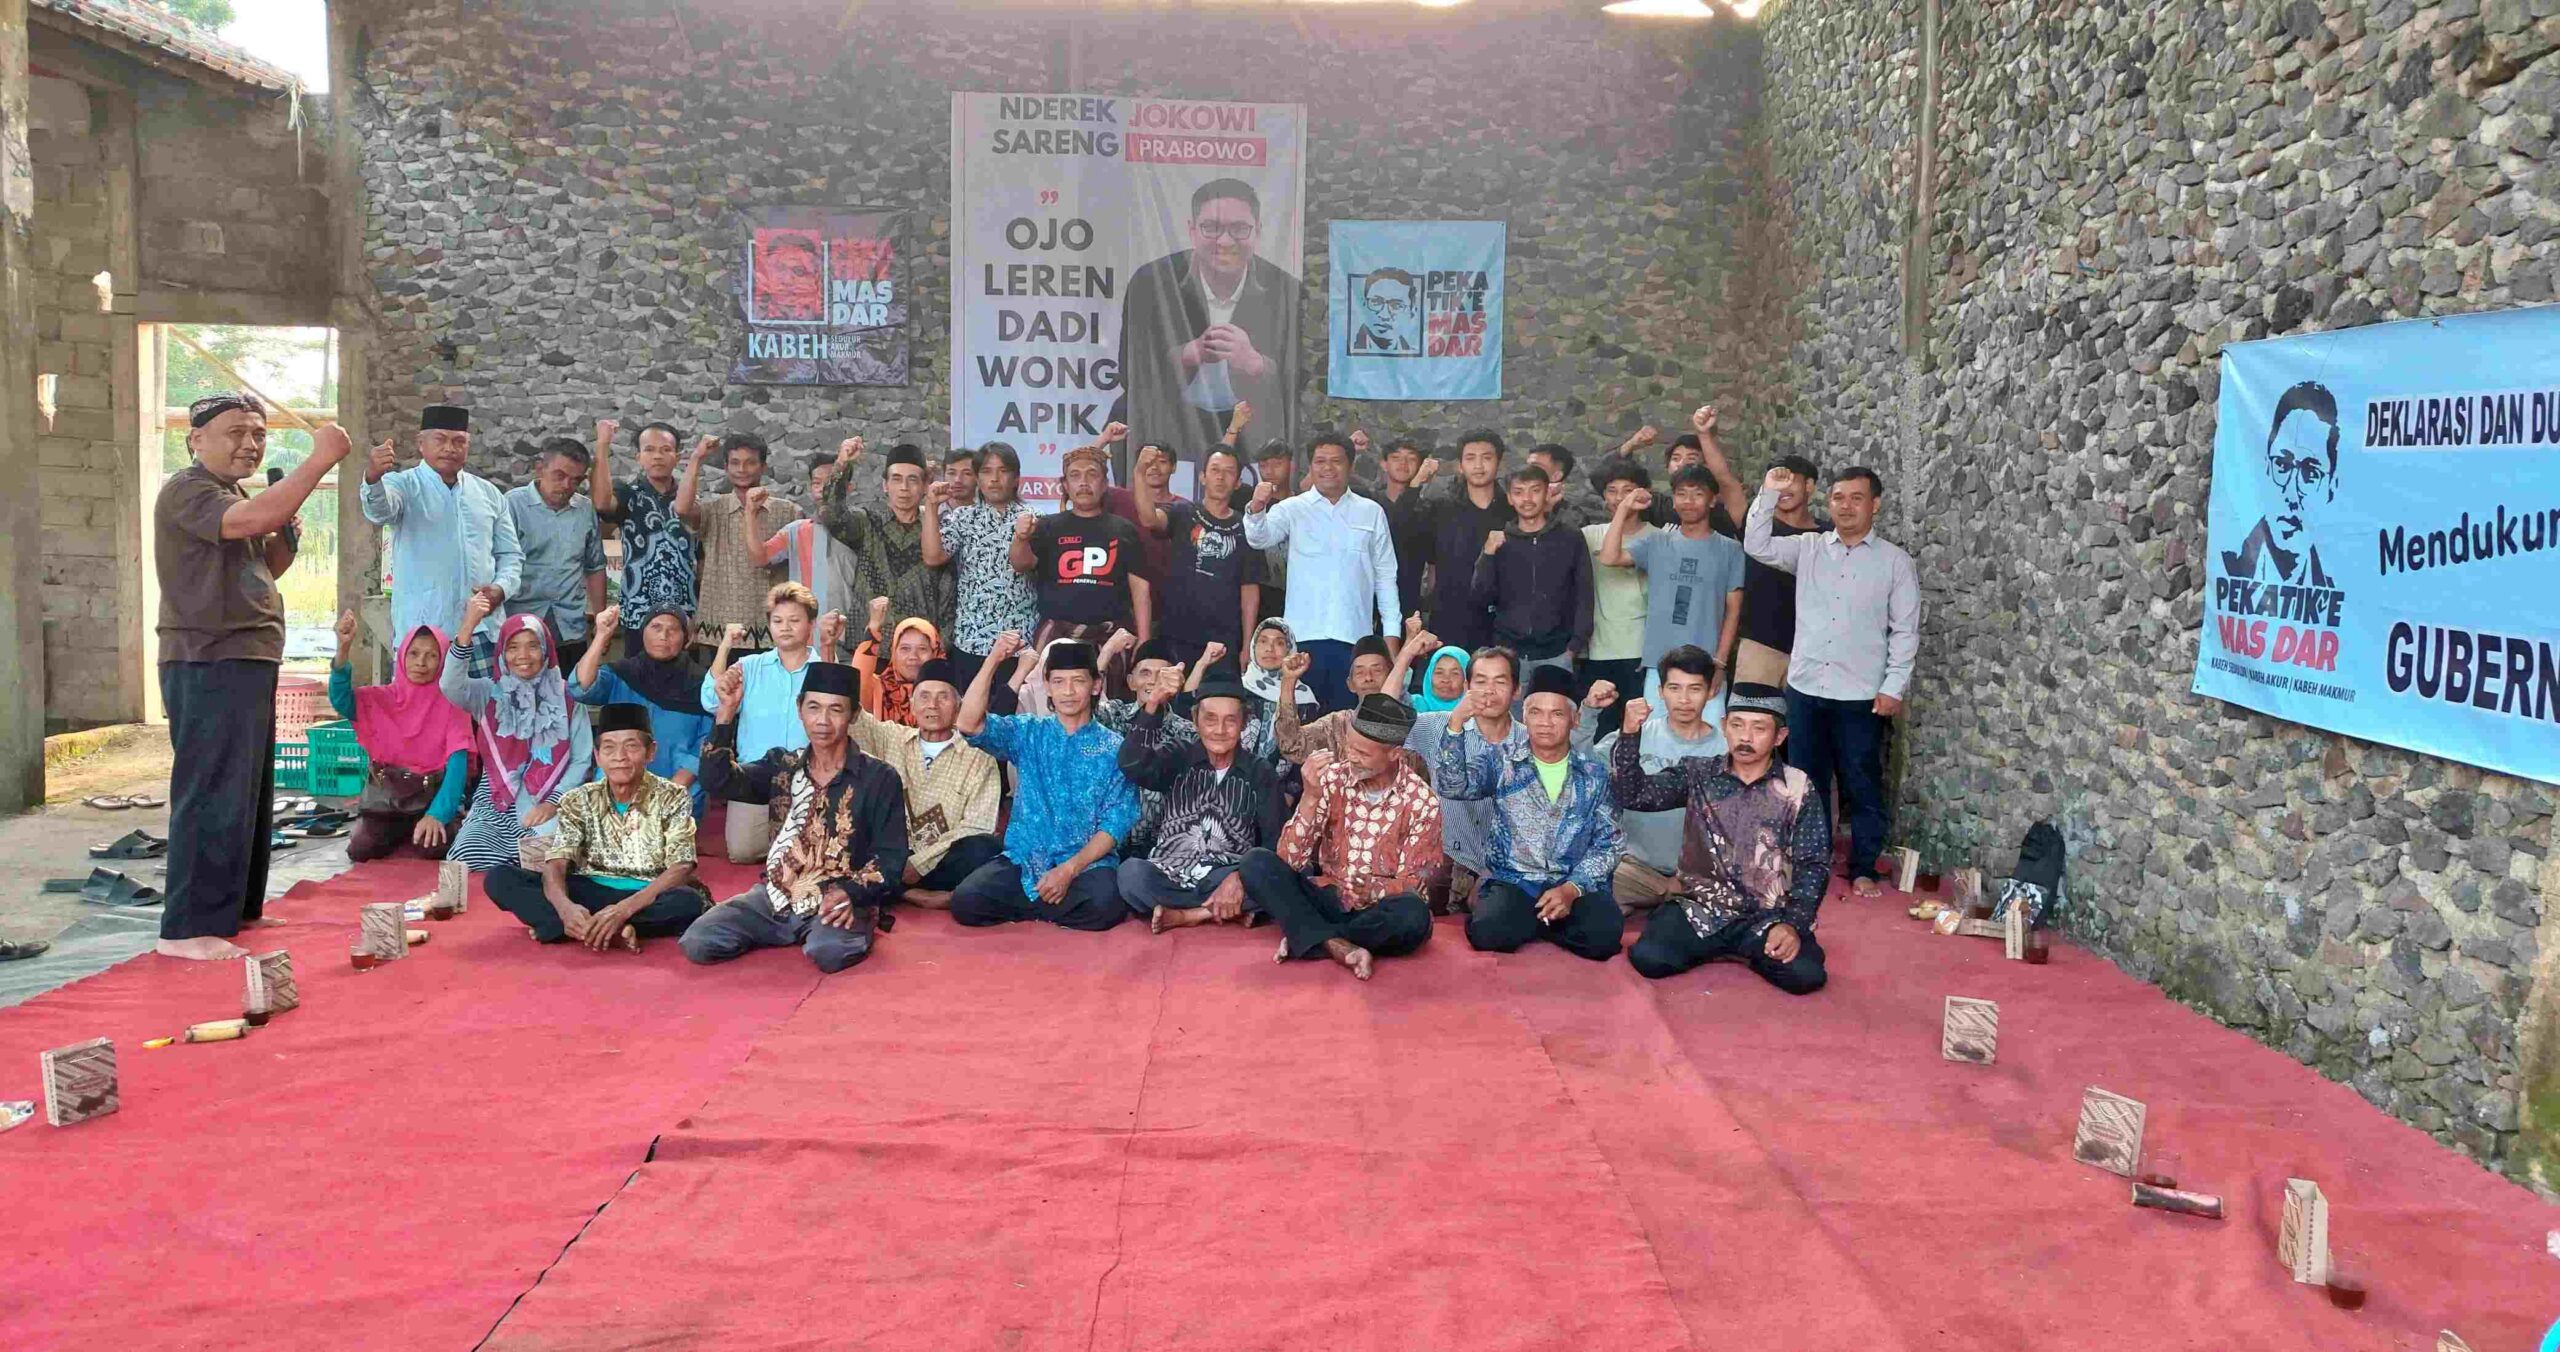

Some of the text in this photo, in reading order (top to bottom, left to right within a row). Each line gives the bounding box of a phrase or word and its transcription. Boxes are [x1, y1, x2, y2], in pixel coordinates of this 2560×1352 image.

[1000, 97, 1255, 132] NDEREK JOKOWI
[992, 129, 1255, 161] SARENG PRABOWO
[1005, 217, 1094, 251] OJO
[832, 280, 893, 303] MAS
[984, 263, 1114, 299] LEREN
[1427, 270, 1489, 291] PEKA
[832, 303, 888, 326] DAR
[998, 309, 1100, 345] DADI
[1428, 311, 1488, 335] MAS
[748, 333, 828, 359] KABEH
[1428, 335, 1483, 357] DAR
[976, 355, 1120, 391] WONG
[997, 402, 1100, 436] APIK
[2365, 396, 2473, 447] DEKLARASI
[2479, 393, 2524, 445] DAN
[1058, 539, 1118, 579] GPJ
[2216, 577, 2345, 627] PEKATIK'E
[2218, 614, 2339, 672] MAS DAR
[2266, 673, 2289, 689] AKUR
[2293, 678, 2318, 695] KABEH
[2318, 684, 2356, 702] MAKMUR
